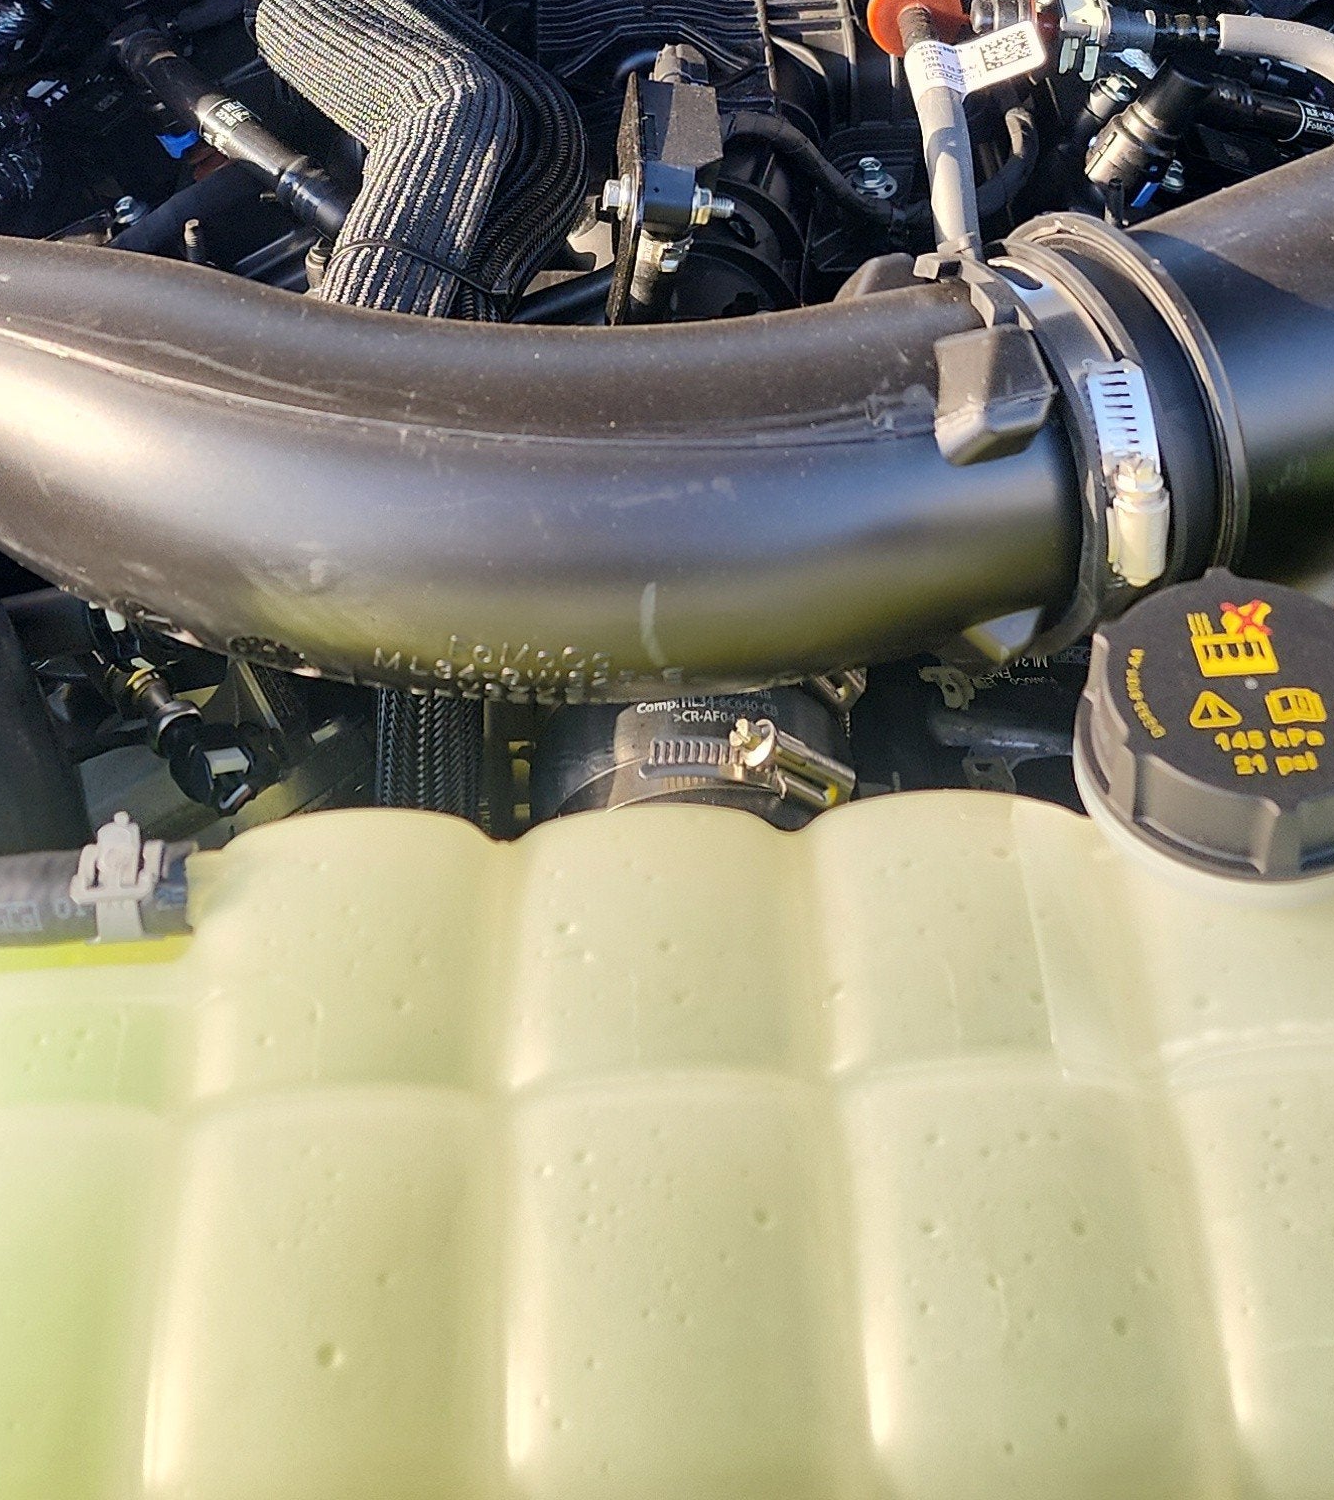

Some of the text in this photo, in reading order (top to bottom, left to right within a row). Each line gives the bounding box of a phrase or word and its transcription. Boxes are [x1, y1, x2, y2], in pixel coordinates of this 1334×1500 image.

[1214, 728, 1326, 752] 145 kPa
[1233, 751, 1319, 777] 21 psi
